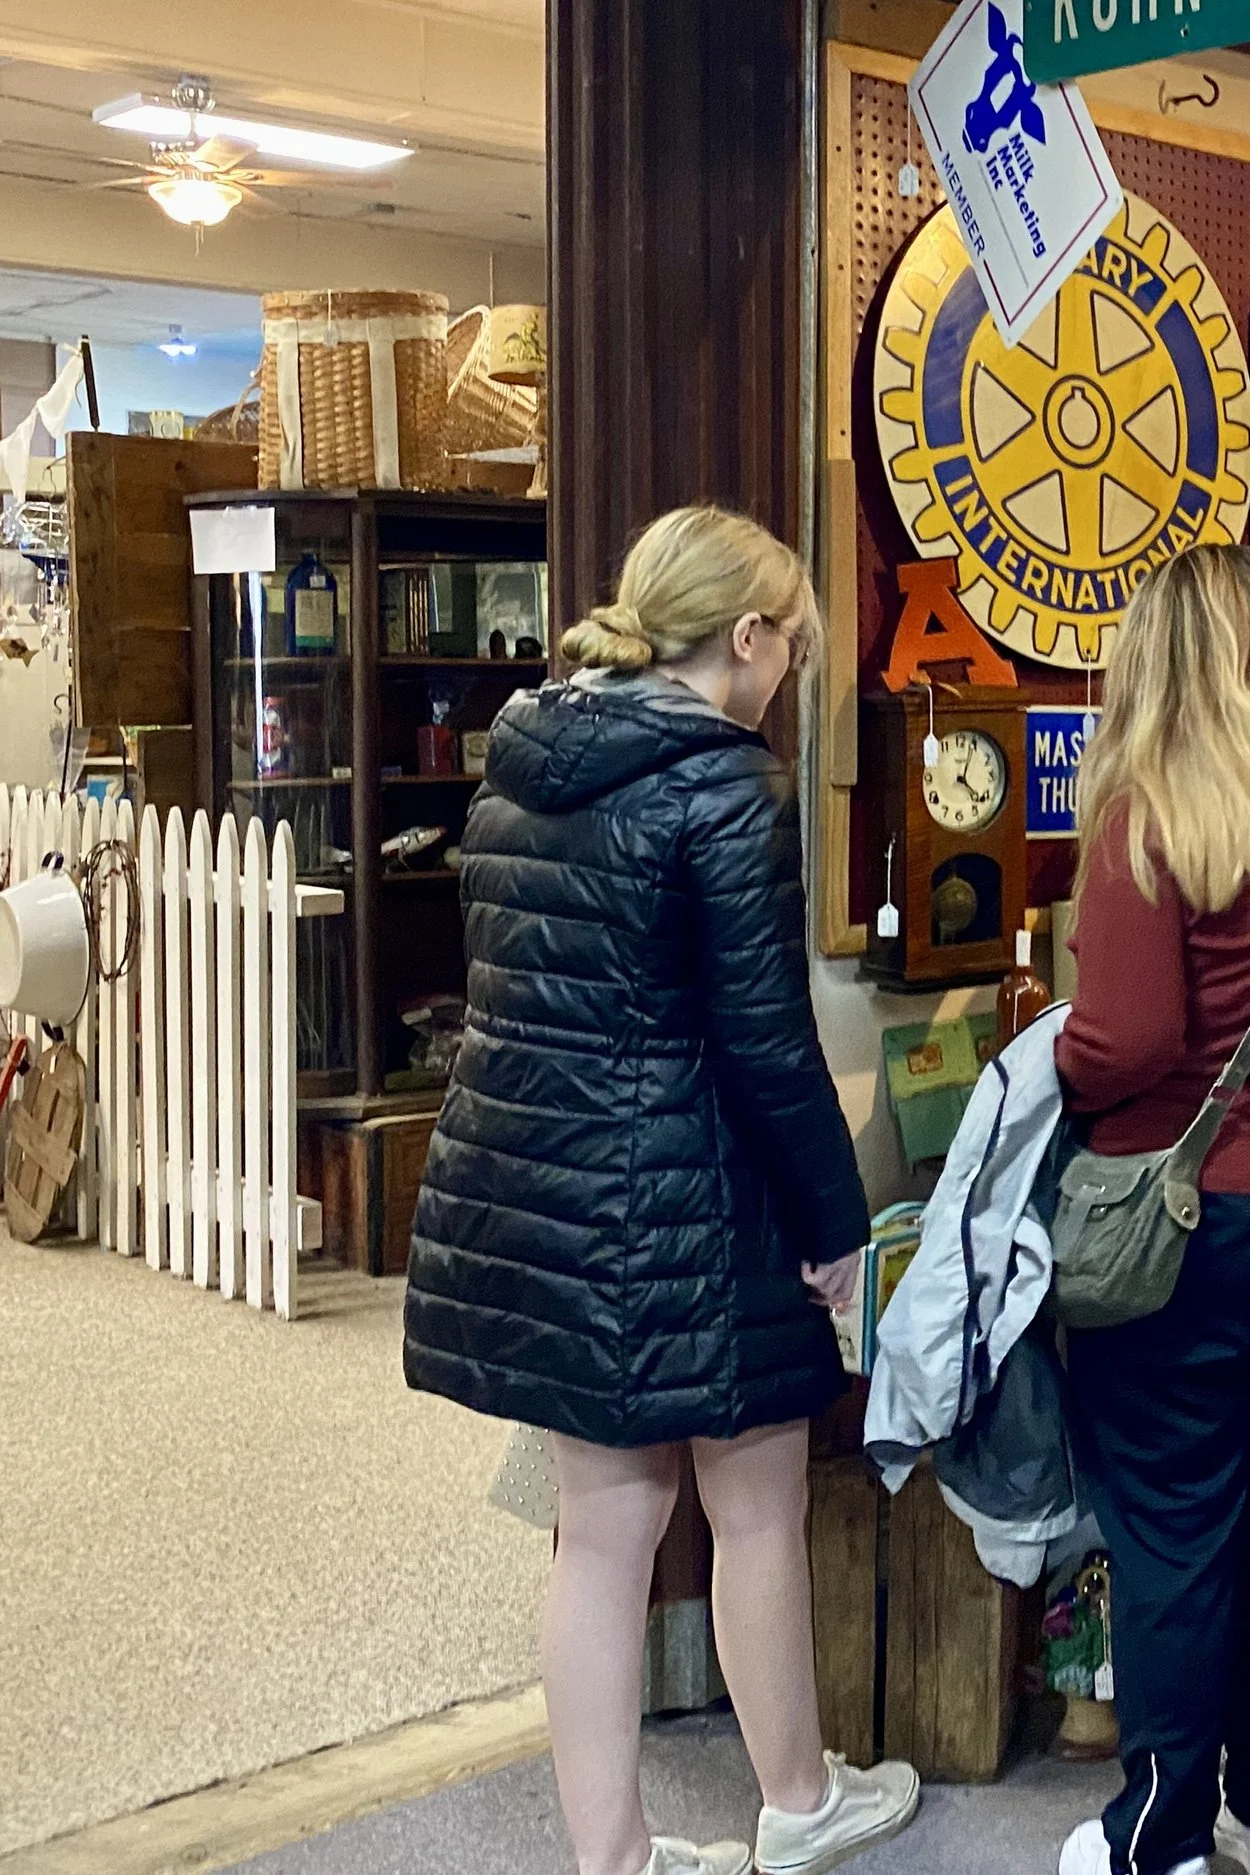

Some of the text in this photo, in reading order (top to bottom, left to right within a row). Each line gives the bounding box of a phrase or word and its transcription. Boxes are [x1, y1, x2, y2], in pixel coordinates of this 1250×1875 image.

[986, 156, 1003, 190] Inc
[1008, 132, 1034, 184] Milk
[942, 153, 985, 257] MEMBER
[997, 145, 1047, 258] Marketing
[945, 474, 1204, 609] INTERNATIONAL
[880, 558, 1018, 692] A
[941, 741, 949, 753] 11
[941, 805, 949, 818] 7
[955, 809, 964, 821] 6
